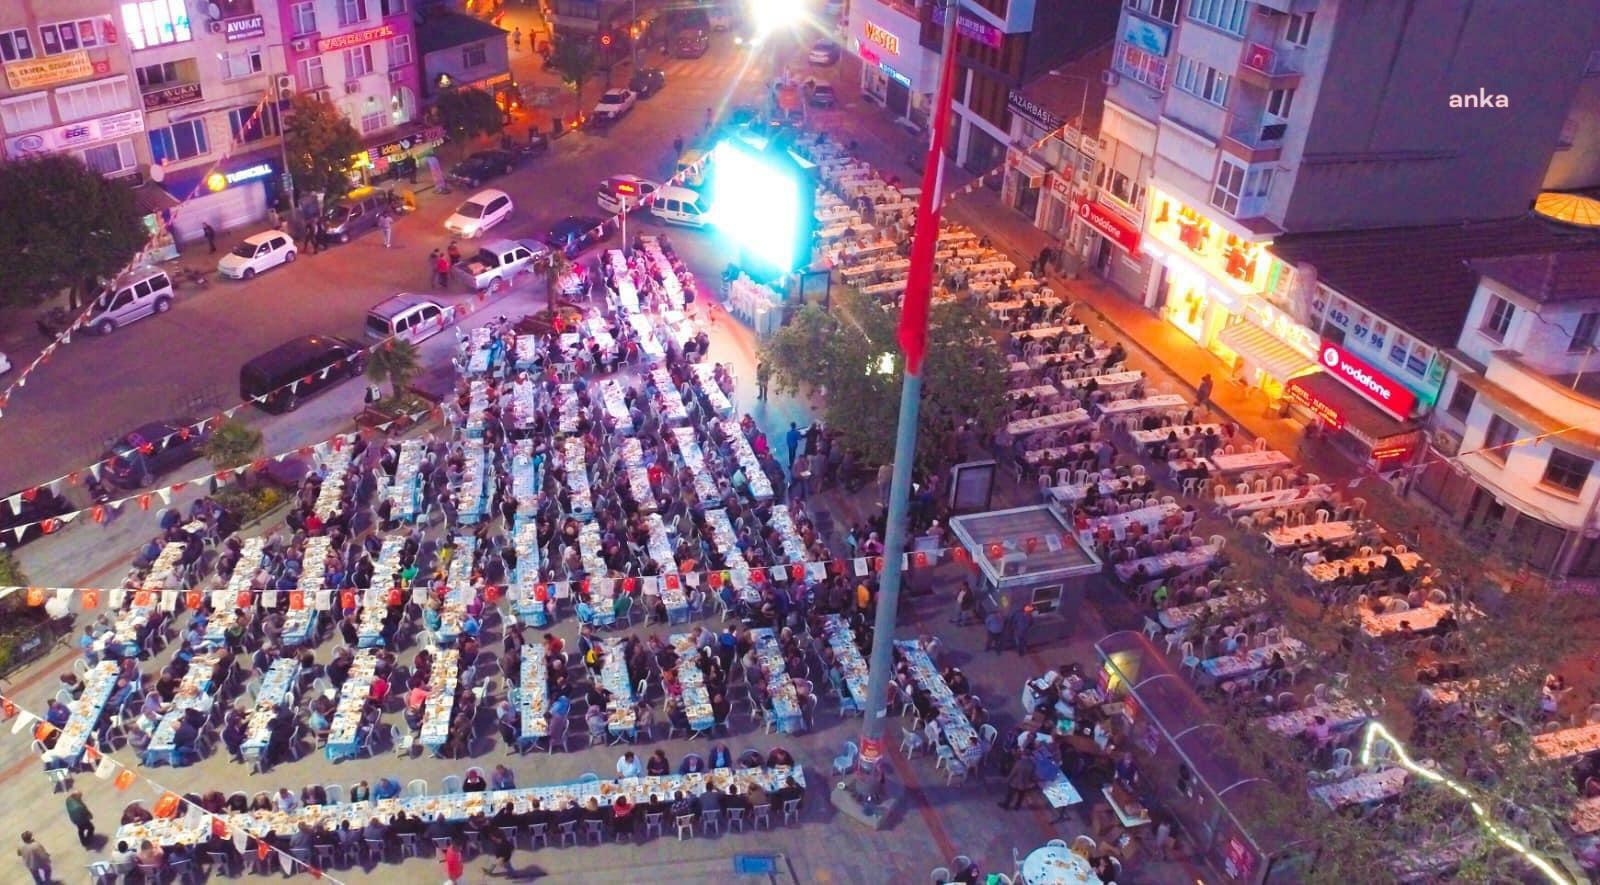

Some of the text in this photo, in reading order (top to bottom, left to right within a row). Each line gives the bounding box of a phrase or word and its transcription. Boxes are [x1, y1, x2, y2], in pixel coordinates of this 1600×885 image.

[227, 17, 262, 33] AVUKAT
[164, 83, 200, 98] AVUKAT
[65, 126, 89, 139] EGE
[1090, 211, 1121, 238] vodafone
[1330, 309, 1349, 328] 482
[1354, 324, 1368, 338] 97
[1371, 333, 1384, 349] 96
[1341, 360, 1391, 399] vodafone
